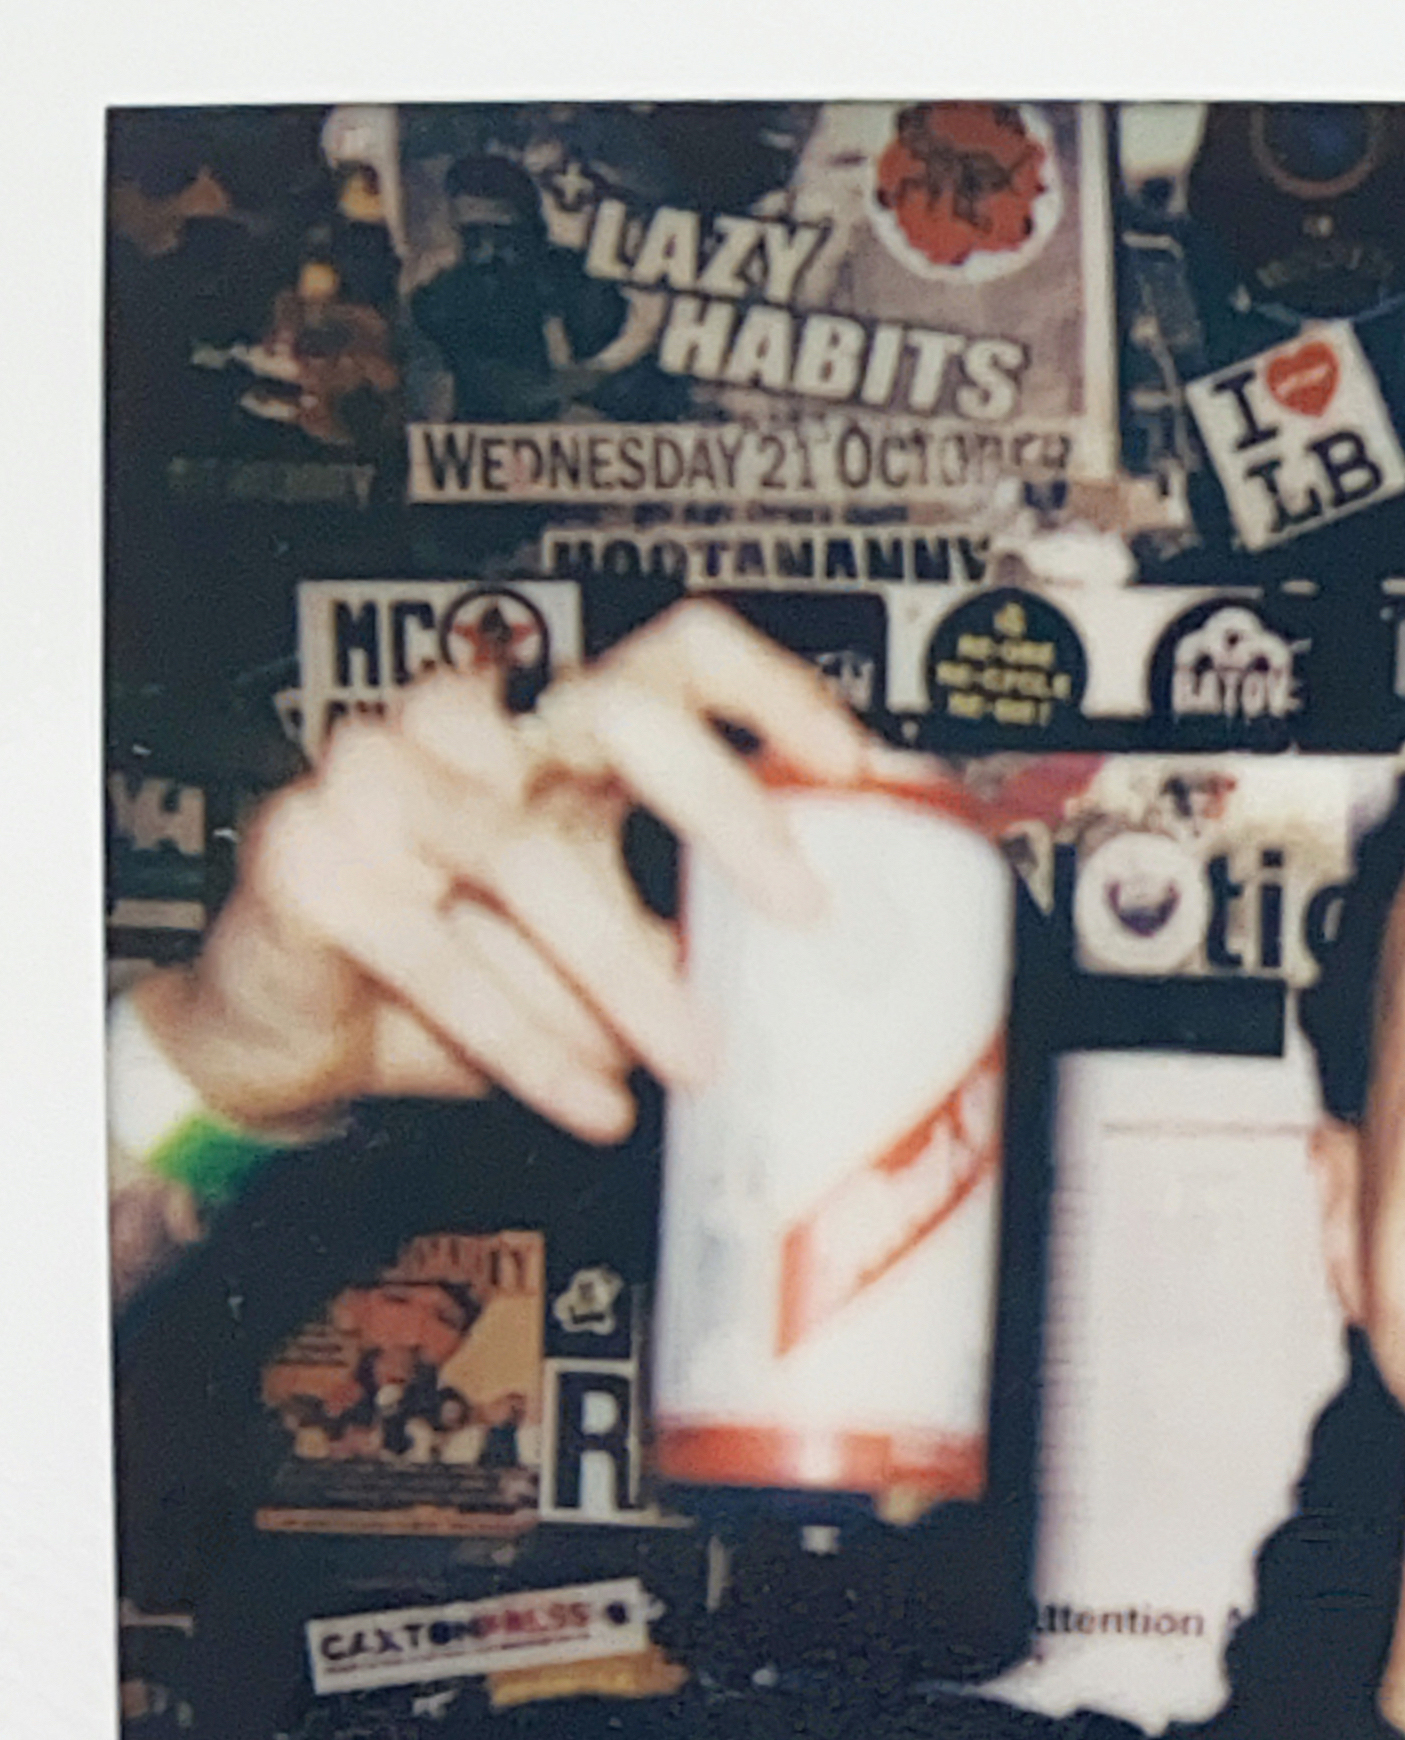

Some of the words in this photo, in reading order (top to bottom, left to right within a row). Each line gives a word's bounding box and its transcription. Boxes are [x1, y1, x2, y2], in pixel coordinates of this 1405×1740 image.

[586, 198, 832, 300] LAZY
[659, 298, 1027, 420] HABITS
[422, 430, 744, 491] WEDNESDAY
[1034, 1603, 1205, 1636] ttention
